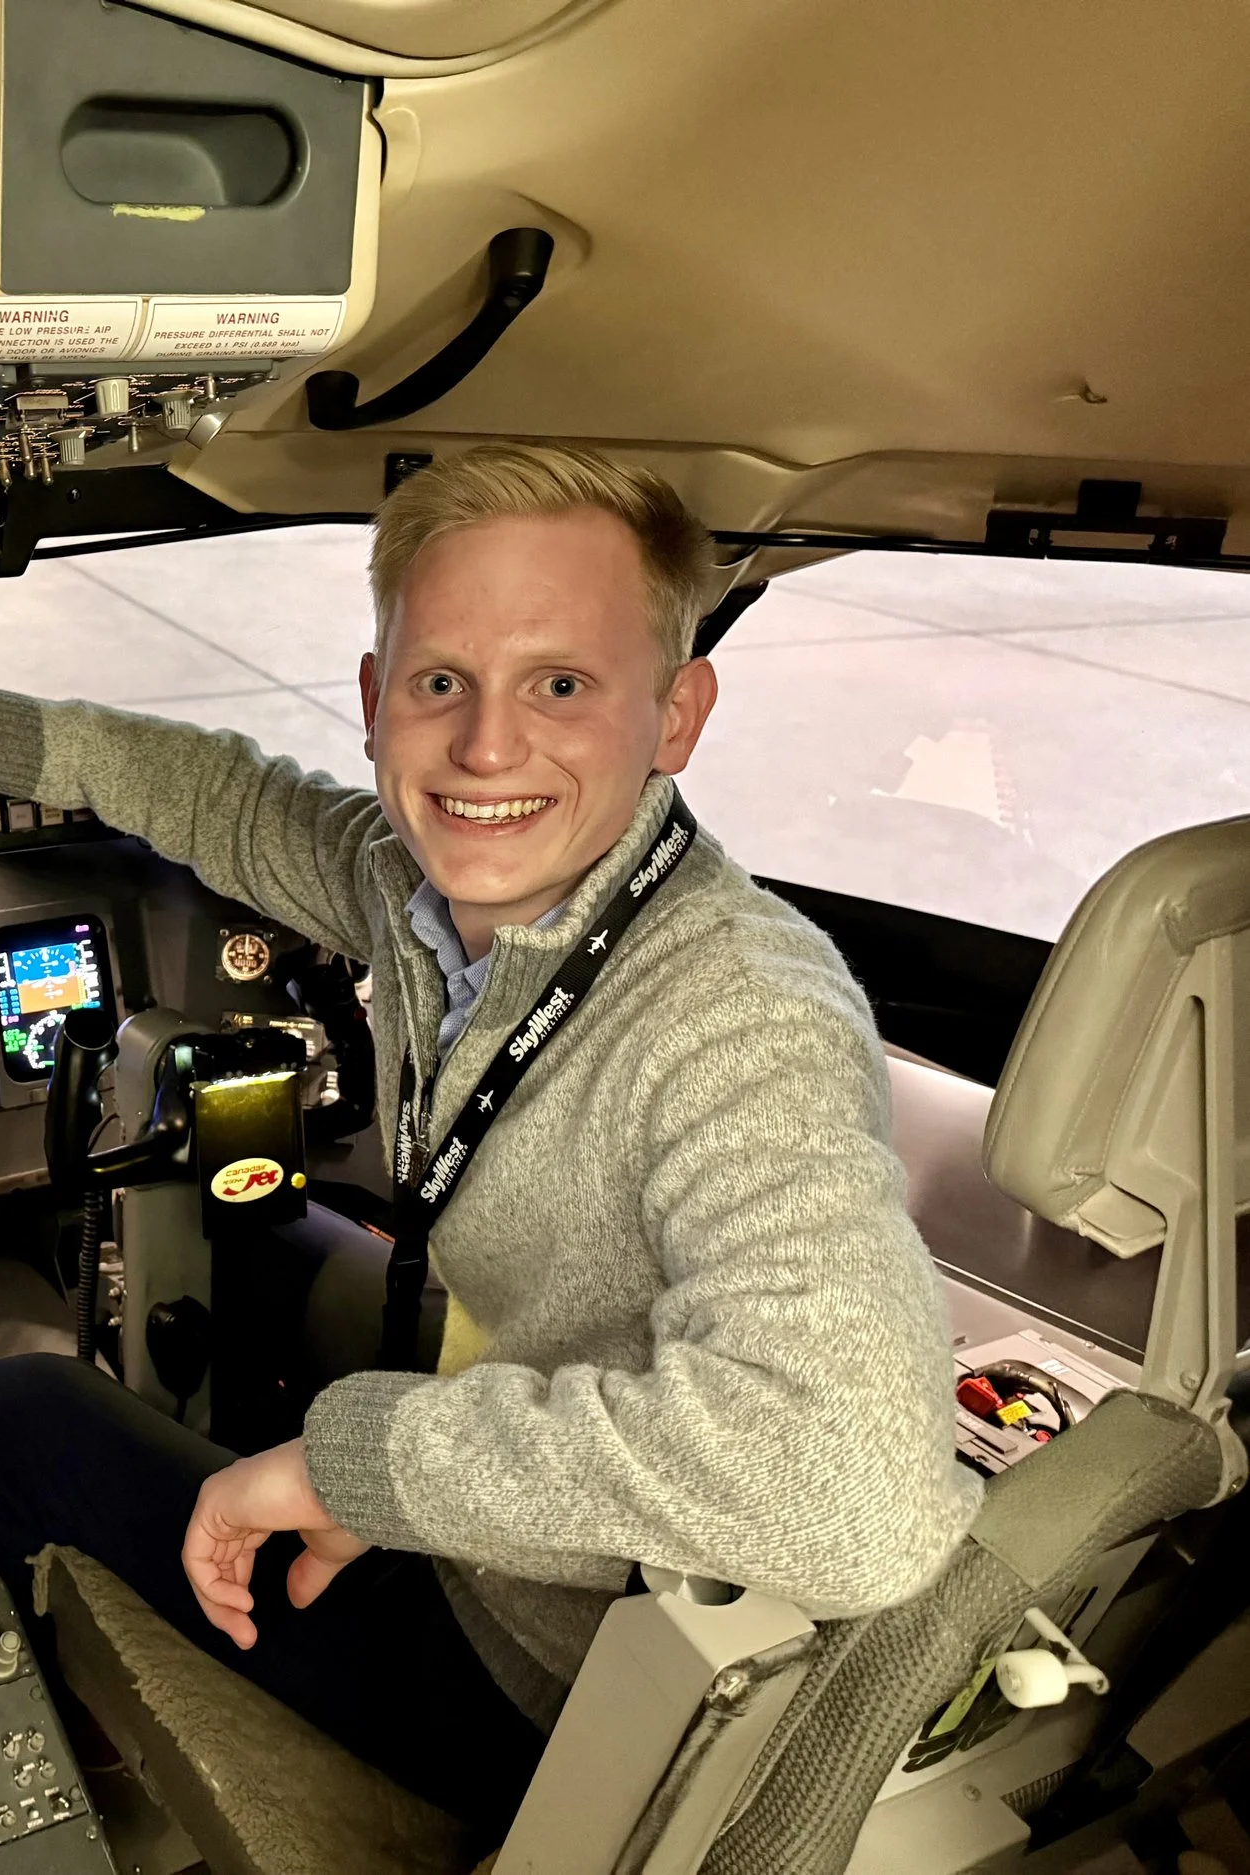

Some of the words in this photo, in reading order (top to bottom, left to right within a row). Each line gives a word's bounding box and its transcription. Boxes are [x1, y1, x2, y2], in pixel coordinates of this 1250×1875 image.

[0, 310, 69, 323] WARNING
[9, 327, 32, 335] LOW
[154, 331, 205, 339] PRESSURE
[209, 330, 273, 338] DIFFERENTIAL
[278, 329, 306, 337] SHALL
[217, 313, 280, 324] WARNING
[54, 338, 64, 346] IS
[630, 822, 686, 898] SkyWest
[659, 834, 688, 875] AIRLINES
[509, 986, 569, 1062] SkyWest
[540, 997, 573, 1040] AIRLINES
[399, 1100, 412, 1181] SkyWest
[420, 1136, 464, 1203] SkyWest
